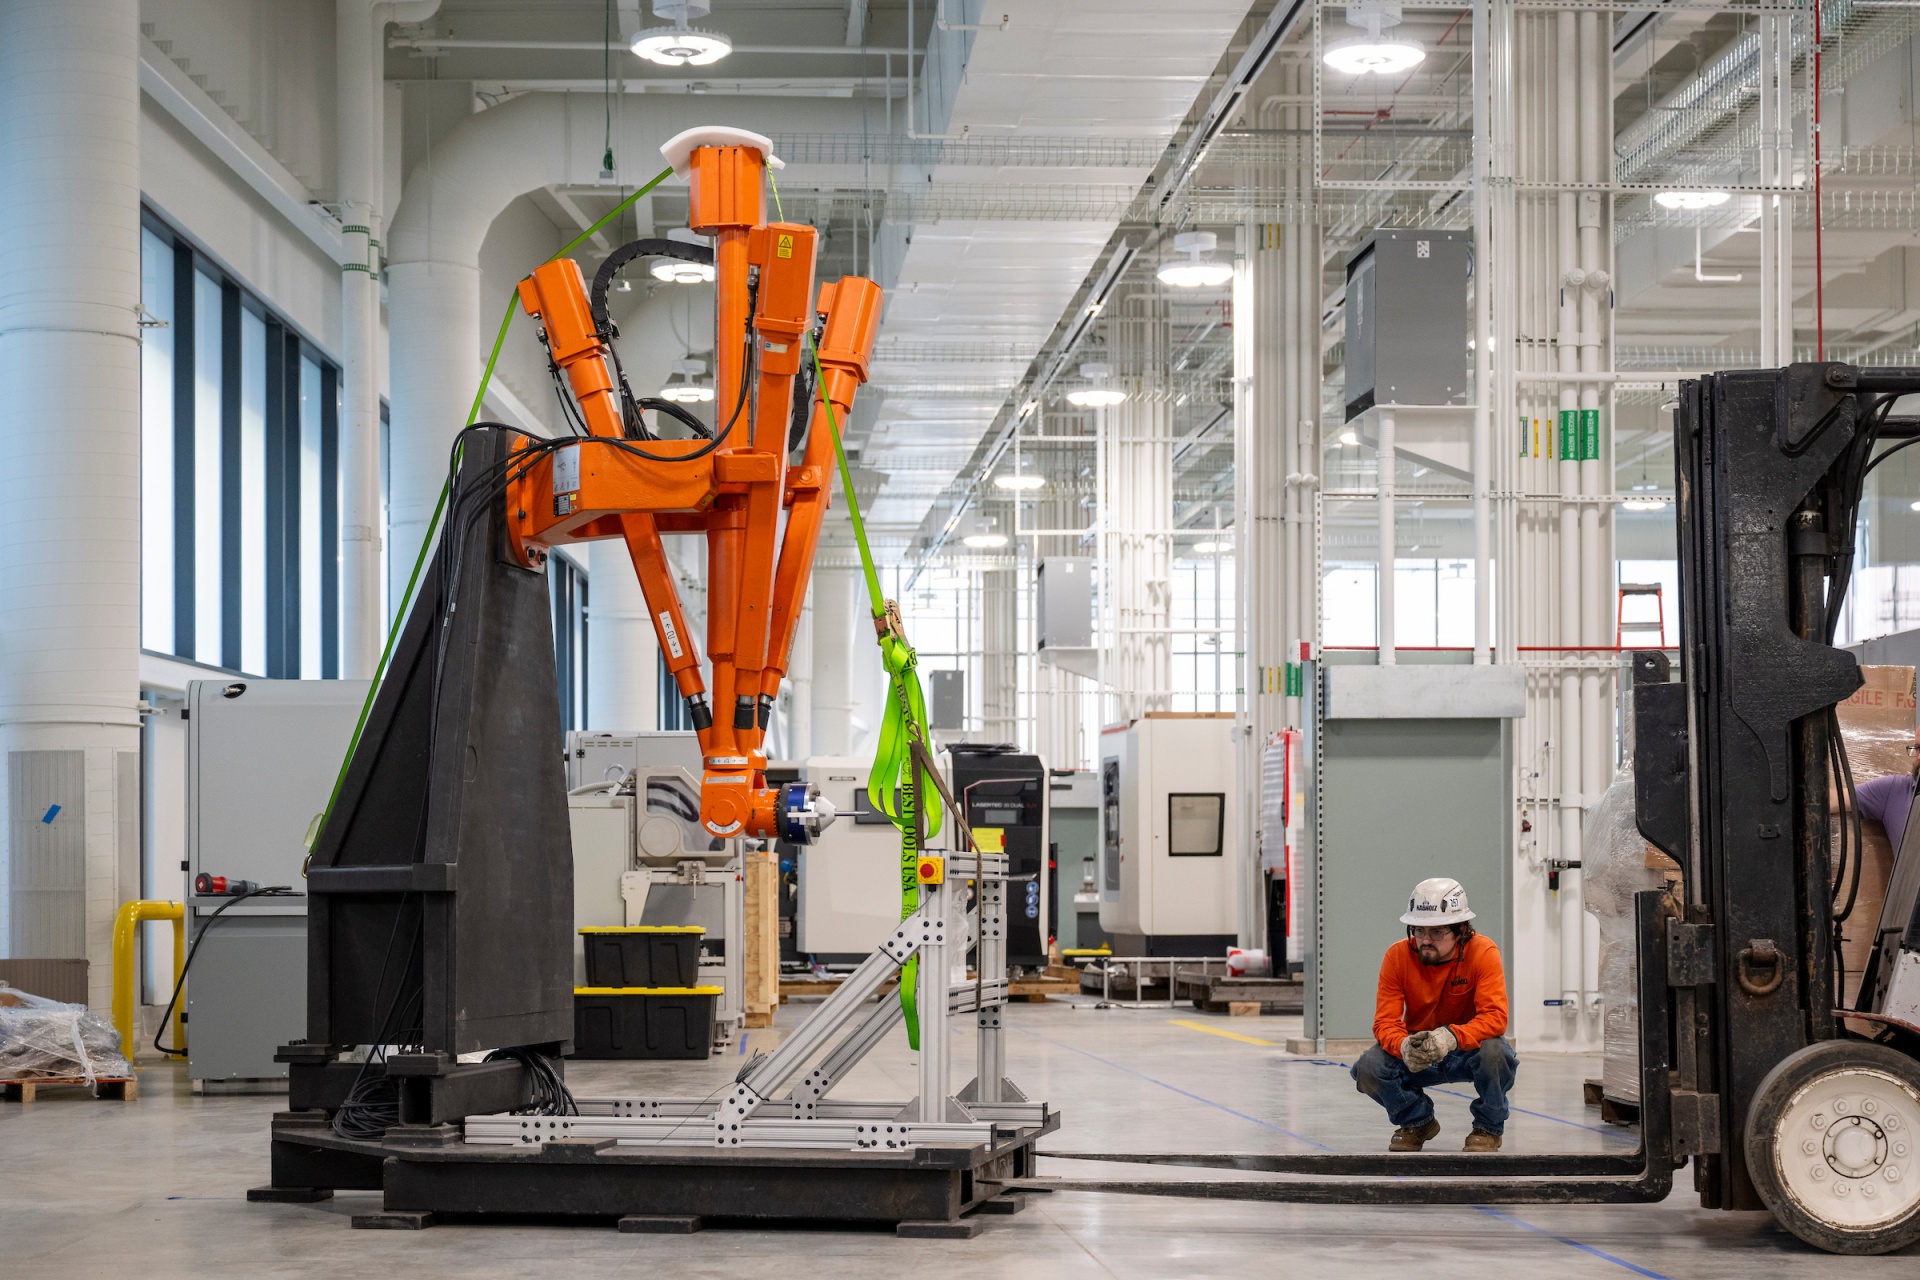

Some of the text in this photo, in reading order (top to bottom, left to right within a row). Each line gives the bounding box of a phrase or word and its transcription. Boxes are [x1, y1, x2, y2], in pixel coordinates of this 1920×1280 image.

[1839, 690, 1883, 706] GILE
[902, 783, 915, 816] BEST
[903, 826, 916, 862] OOLS
